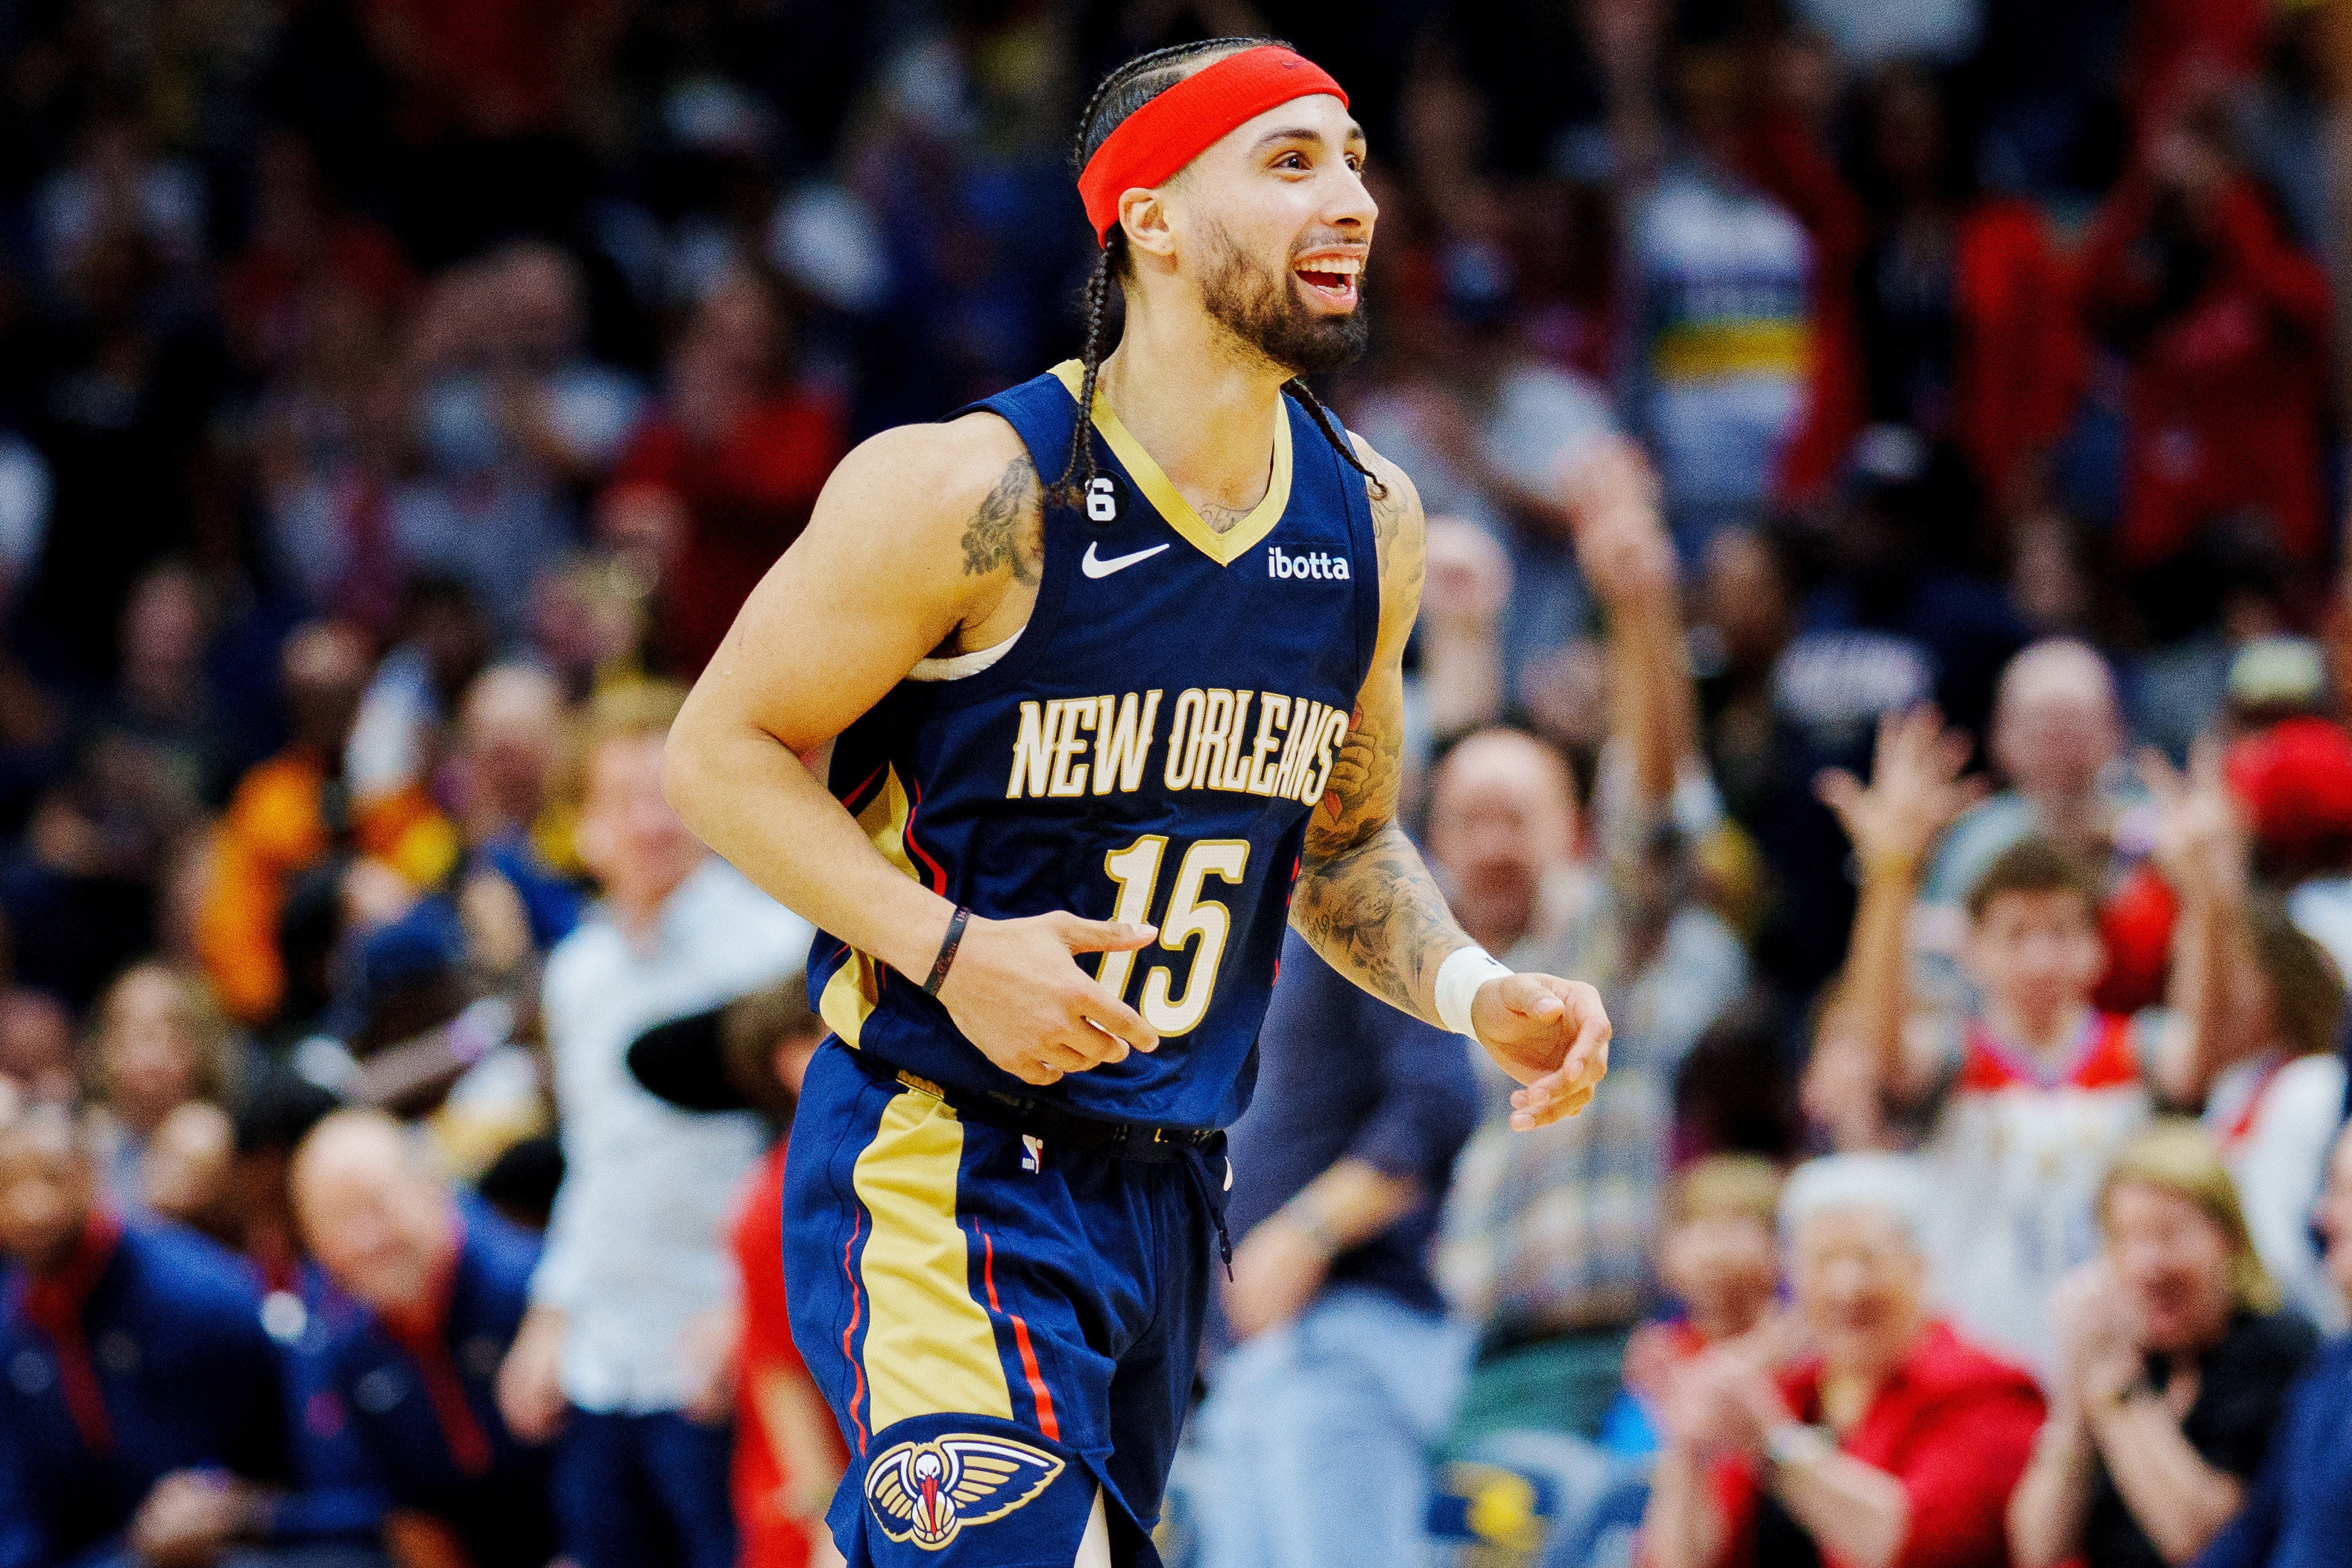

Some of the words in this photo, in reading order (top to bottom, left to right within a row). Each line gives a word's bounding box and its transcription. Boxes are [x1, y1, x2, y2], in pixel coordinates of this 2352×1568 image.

[1084, 478, 1116, 521] 6
[1268, 546, 1350, 580] ibotta
[1006, 689, 1163, 799] NEW
[1164, 688, 1350, 806] ORLEANS
[1088, 834, 1251, 1037] 15
